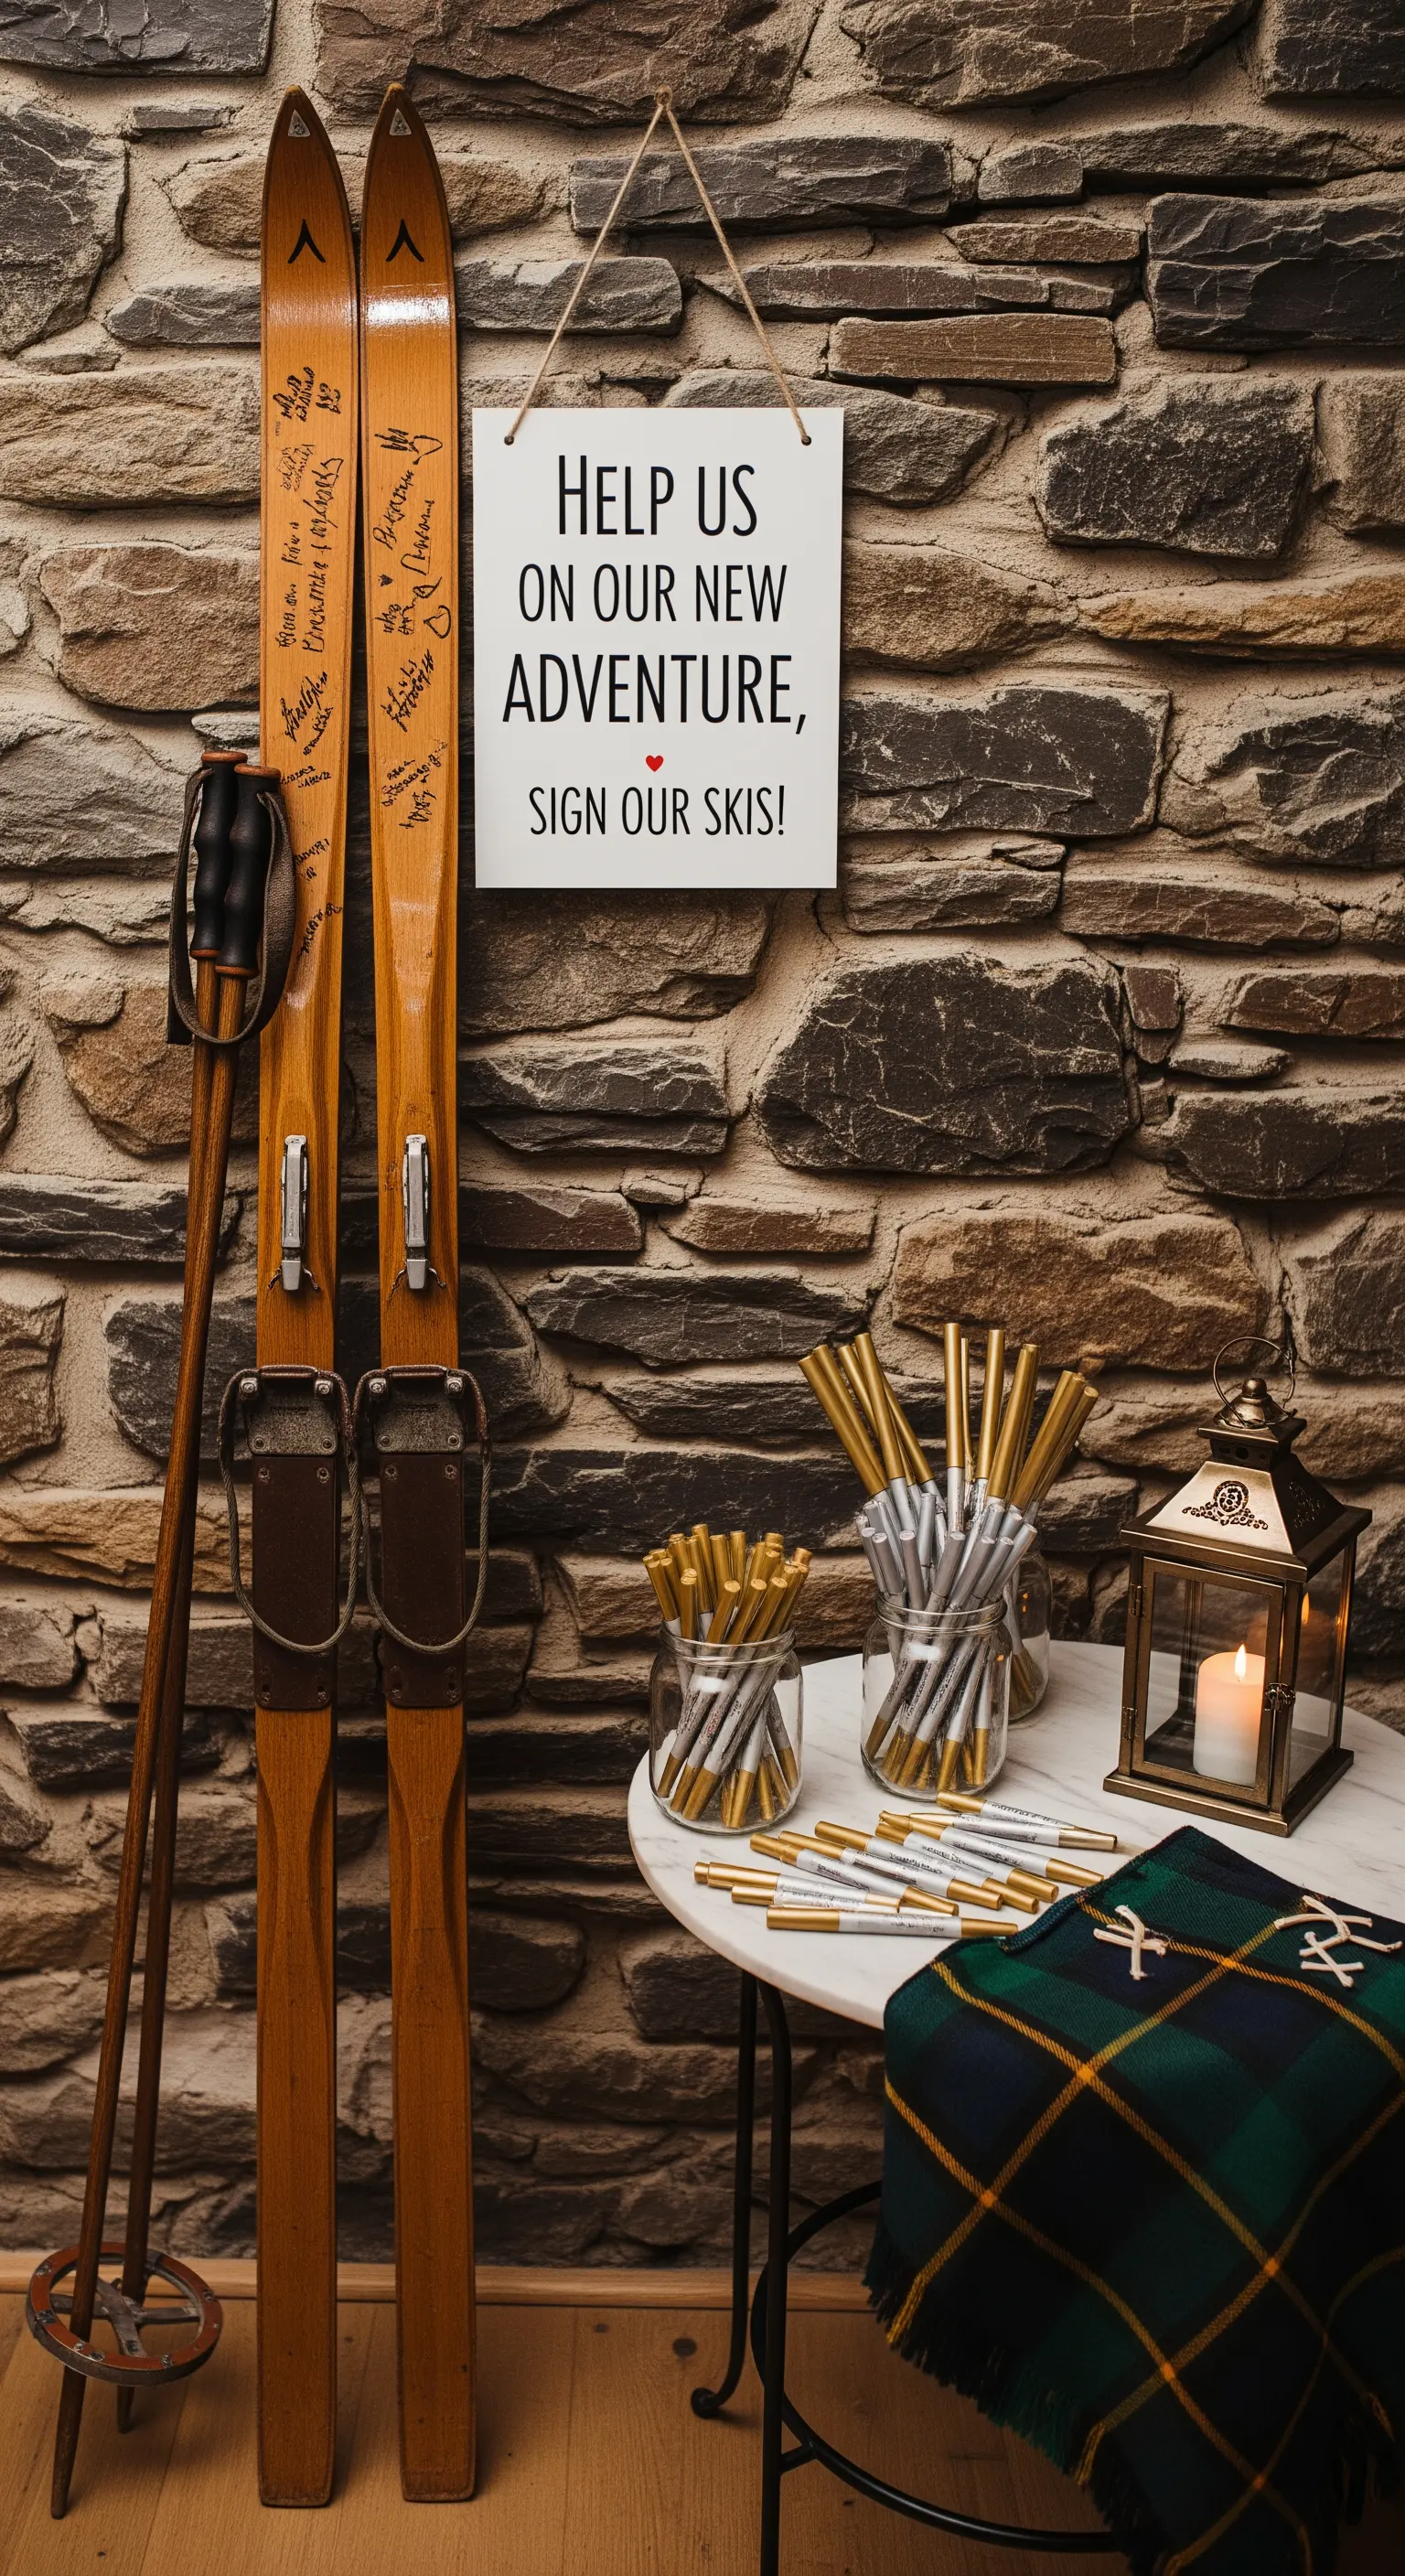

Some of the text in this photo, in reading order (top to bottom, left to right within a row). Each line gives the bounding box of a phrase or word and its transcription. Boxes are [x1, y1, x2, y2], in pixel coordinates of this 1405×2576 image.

[558, 455, 758, 538] HELP US
[518, 564, 574, 623] ON
[593, 564, 678, 623] OUR
[694, 564, 788, 623] NEW
[502, 653, 808, 736] ADVENTURE,
[528, 785, 786, 837] SIGN OUR SKIS!
